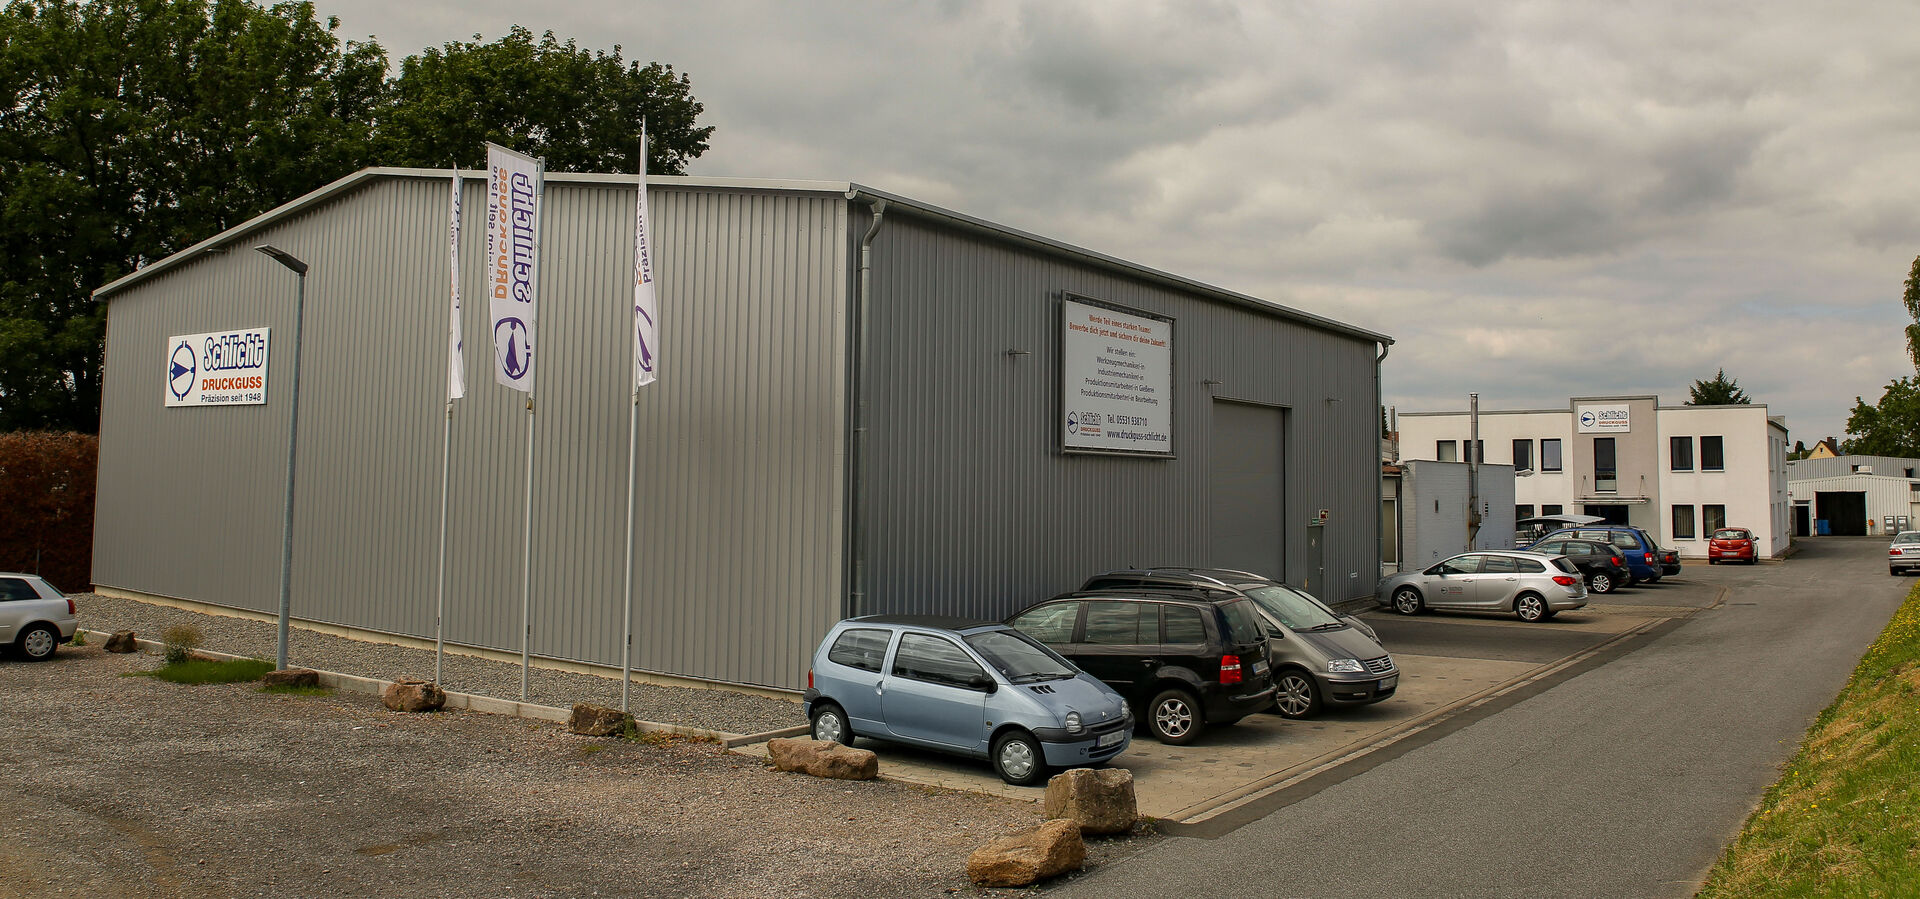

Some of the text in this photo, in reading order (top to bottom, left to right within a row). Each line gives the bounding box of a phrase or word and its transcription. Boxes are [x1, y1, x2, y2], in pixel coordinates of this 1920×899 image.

[1090, 326, 1098, 334] dich
[204, 333, 264, 372] Schlicht
[1114, 348, 1128, 356] stellen
[202, 376, 262, 390] DRUCKGUSS
[201, 392, 262, 402] Präzision seit 1948
[1107, 414, 1116, 424] Tel.
[1107, 429, 1167, 442] www.druckguss-schlicht.de
